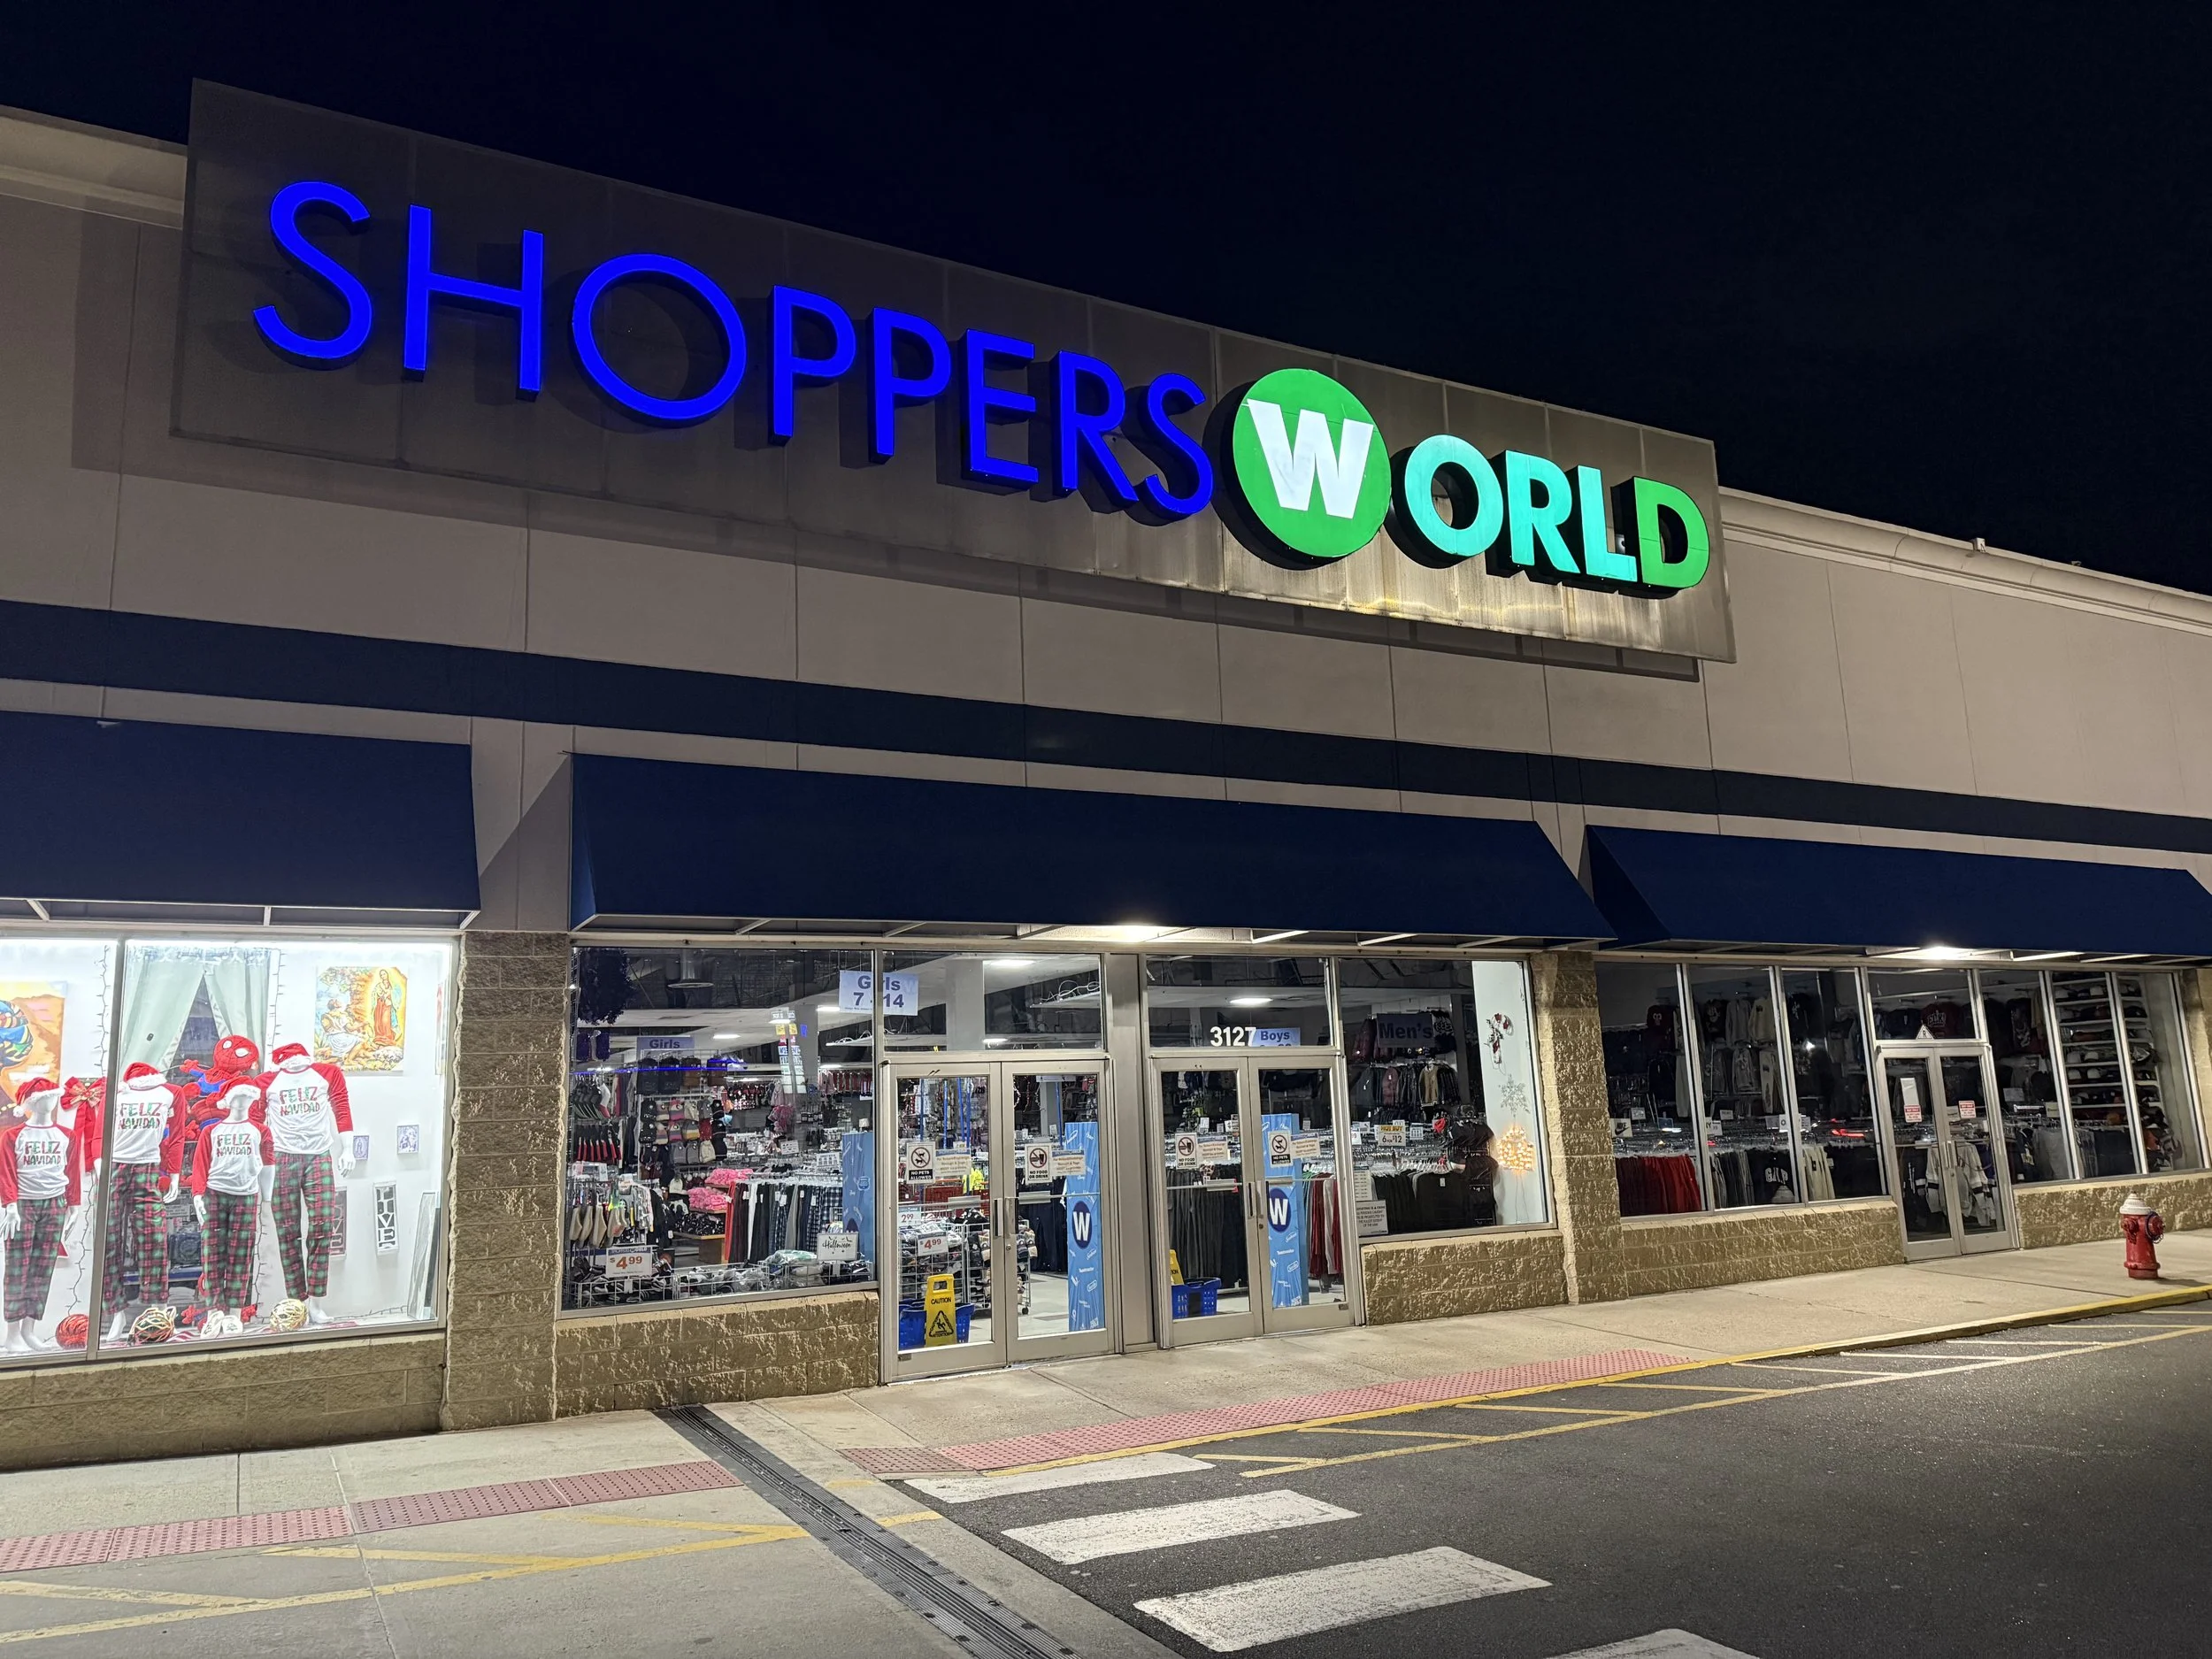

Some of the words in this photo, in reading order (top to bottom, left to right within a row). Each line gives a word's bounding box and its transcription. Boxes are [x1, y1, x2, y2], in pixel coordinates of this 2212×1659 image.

[253, 180, 1214, 519] SHOPPERS
[1244, 396, 1710, 589] WORLD
[853, 992, 864, 1006] 7
[883, 993, 904, 1008] 14
[1210, 1025, 1256, 1047] 3127
[1260, 1030, 1290, 1042] Boys
[1379, 1022, 1432, 1039] Men's
[649, 1039, 680, 1048] Girls
[279, 1087, 318, 1104] FELIZ
[119, 1102, 163, 1117] FELIZ
[280, 1102, 319, 1117] NAVIDAD
[118, 1118, 161, 1130] NAVIDAD
[216, 1133, 250, 1147] FELIZ
[25, 1141, 61, 1155] FELIZ
[216, 1148, 252, 1157] NAVIDAD
[23, 1155, 62, 1165] NAVIDAD
[1270, 1197, 1288, 1225] W
[1072, 1210, 1091, 1241] W
[822, 1237, 851, 1249] Halloween
[931, 1296, 952, 1305] CAUTION
